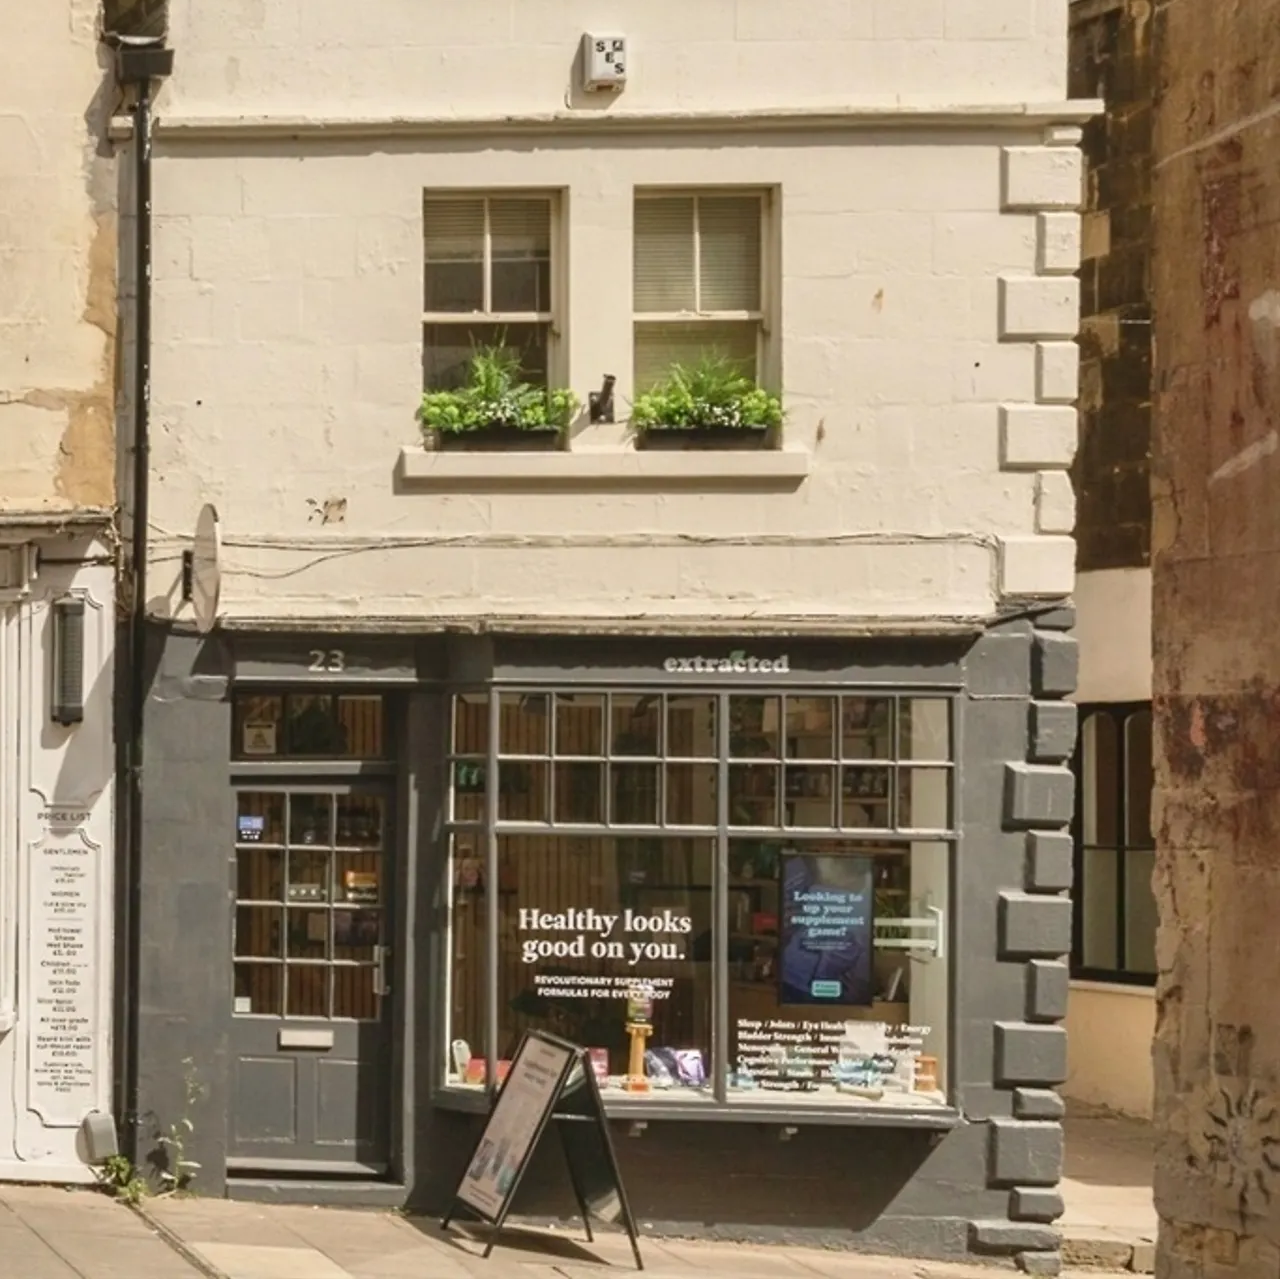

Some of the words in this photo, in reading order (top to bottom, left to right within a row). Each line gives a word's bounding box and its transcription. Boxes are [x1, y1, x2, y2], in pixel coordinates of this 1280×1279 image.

[307, 649, 346, 672] 23
[663, 654, 790, 673] extracted
[37, 812, 68, 821] PRICE
[70, 812, 92, 821] LIST
[518, 908, 618, 937] Healthy
[624, 909, 692, 933] looks
[522, 935, 586, 963] good
[591, 941, 624, 959] on
[627, 941, 686, 965] you.
[534, 975, 612, 986] REVOLUTIONARY
[614, 976, 674, 987] SUPPLEMENT
[537, 987, 589, 998] FORMULAS
[591, 988, 610, 998] FOR
